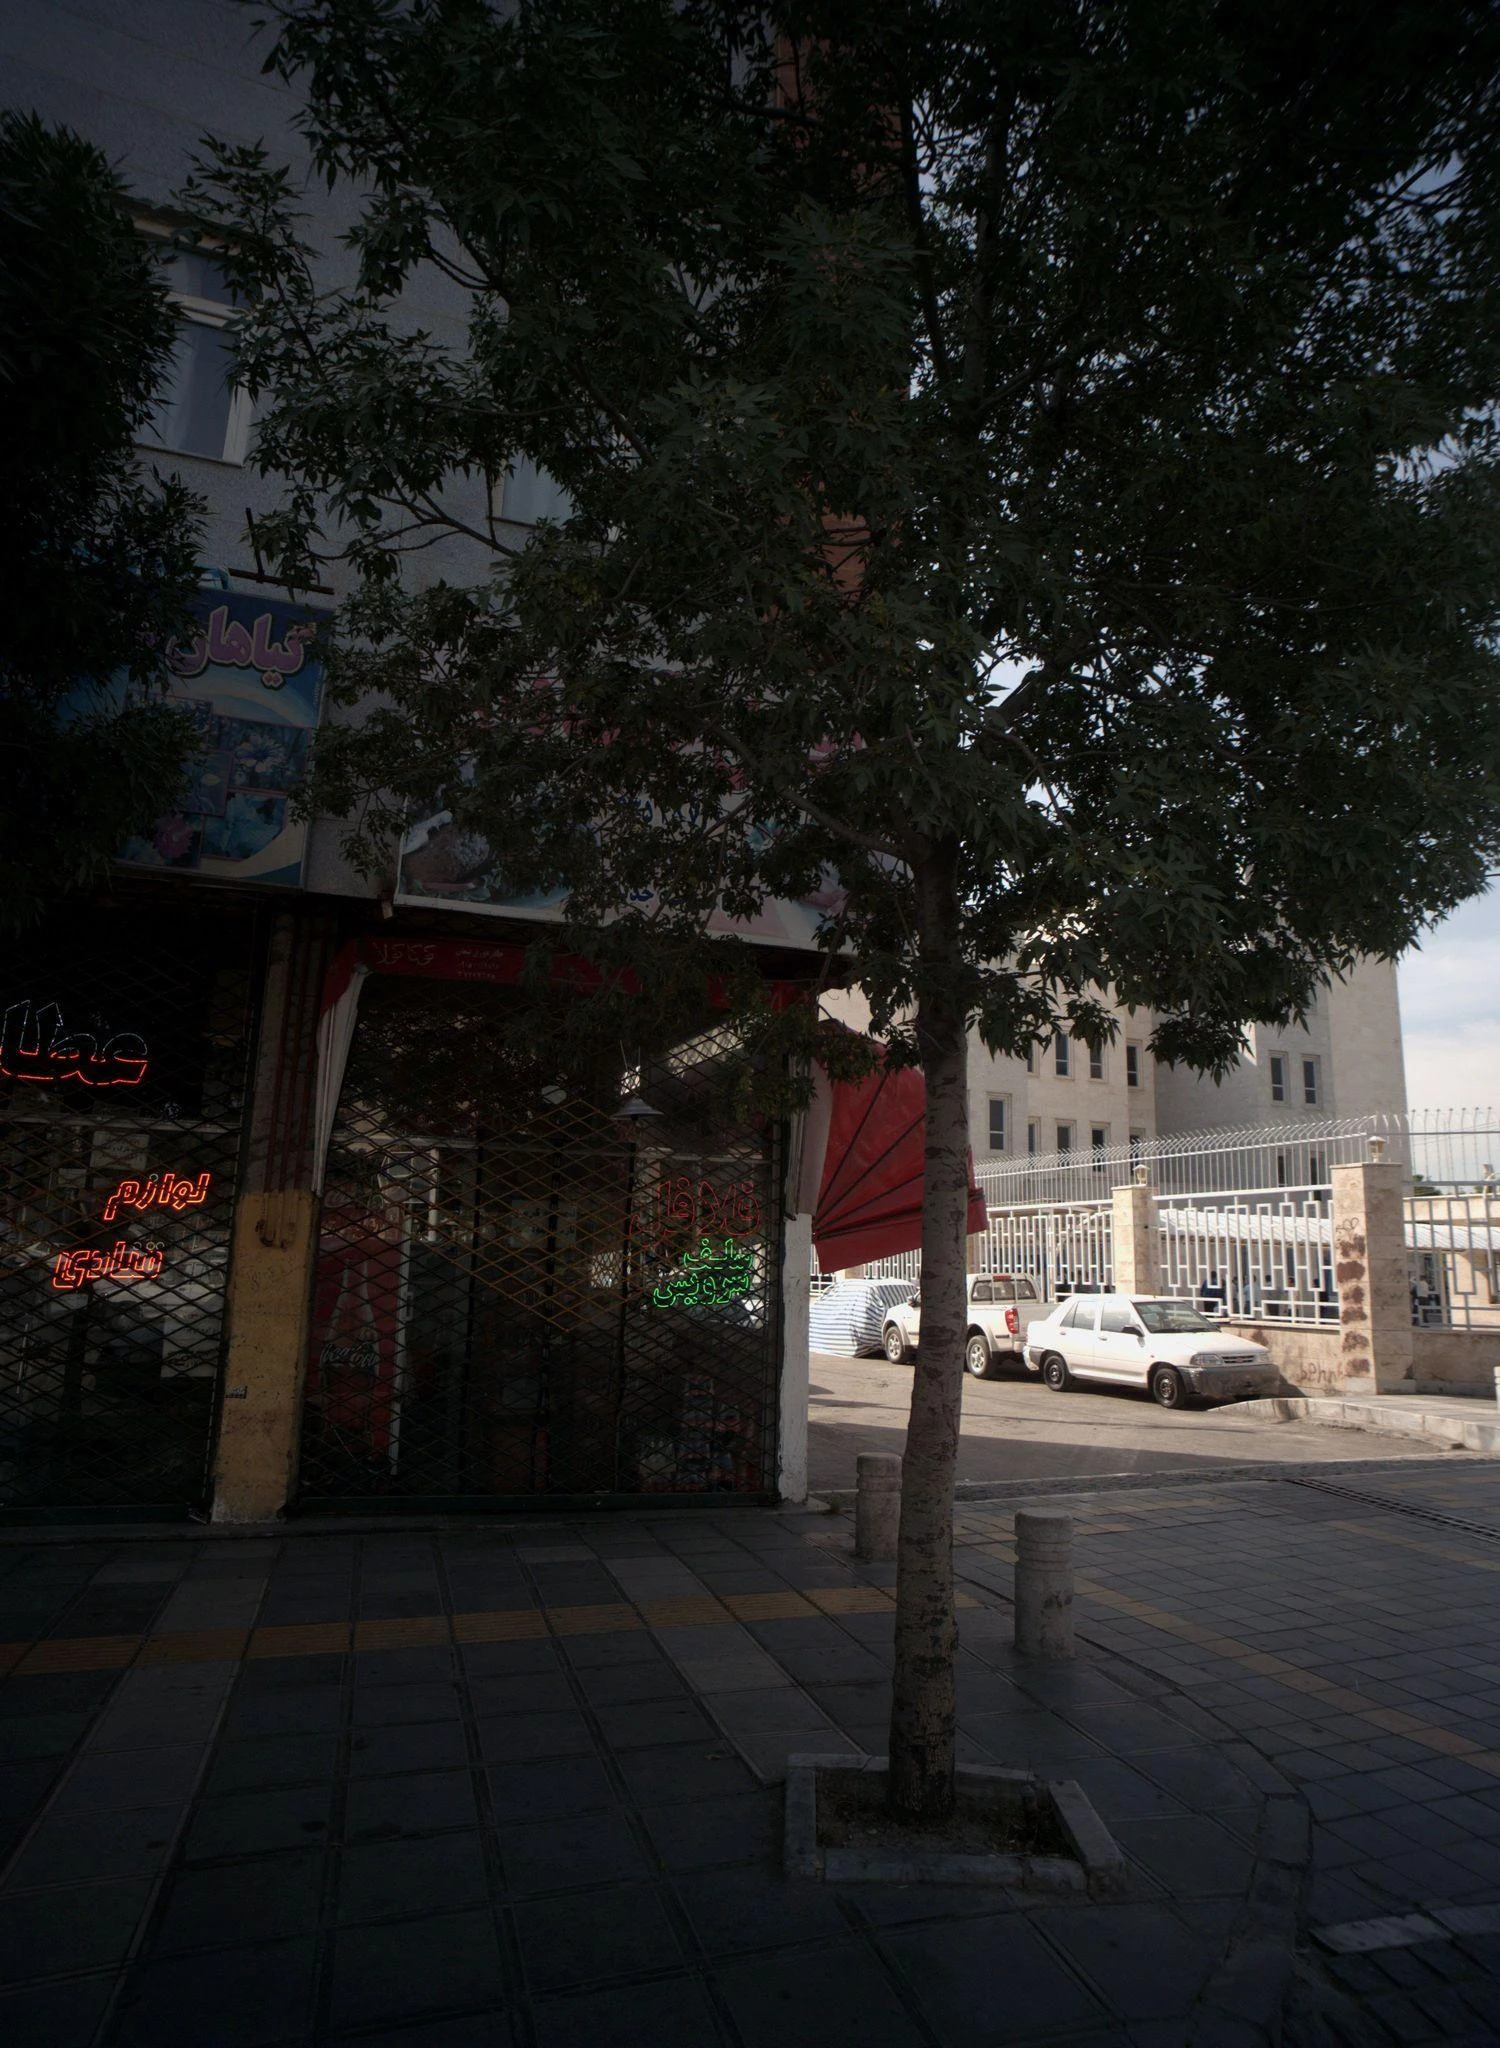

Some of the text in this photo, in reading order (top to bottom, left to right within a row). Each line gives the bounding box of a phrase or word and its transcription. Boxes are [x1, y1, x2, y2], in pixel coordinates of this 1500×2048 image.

[103, 1172, 212, 1222] لوازم
[631, 1175, 761, 1249] فلافل
[51, 1240, 165, 1289] قنادی
[683, 1238, 754, 1271] سلف
[652, 1271, 751, 1308] سرویس
